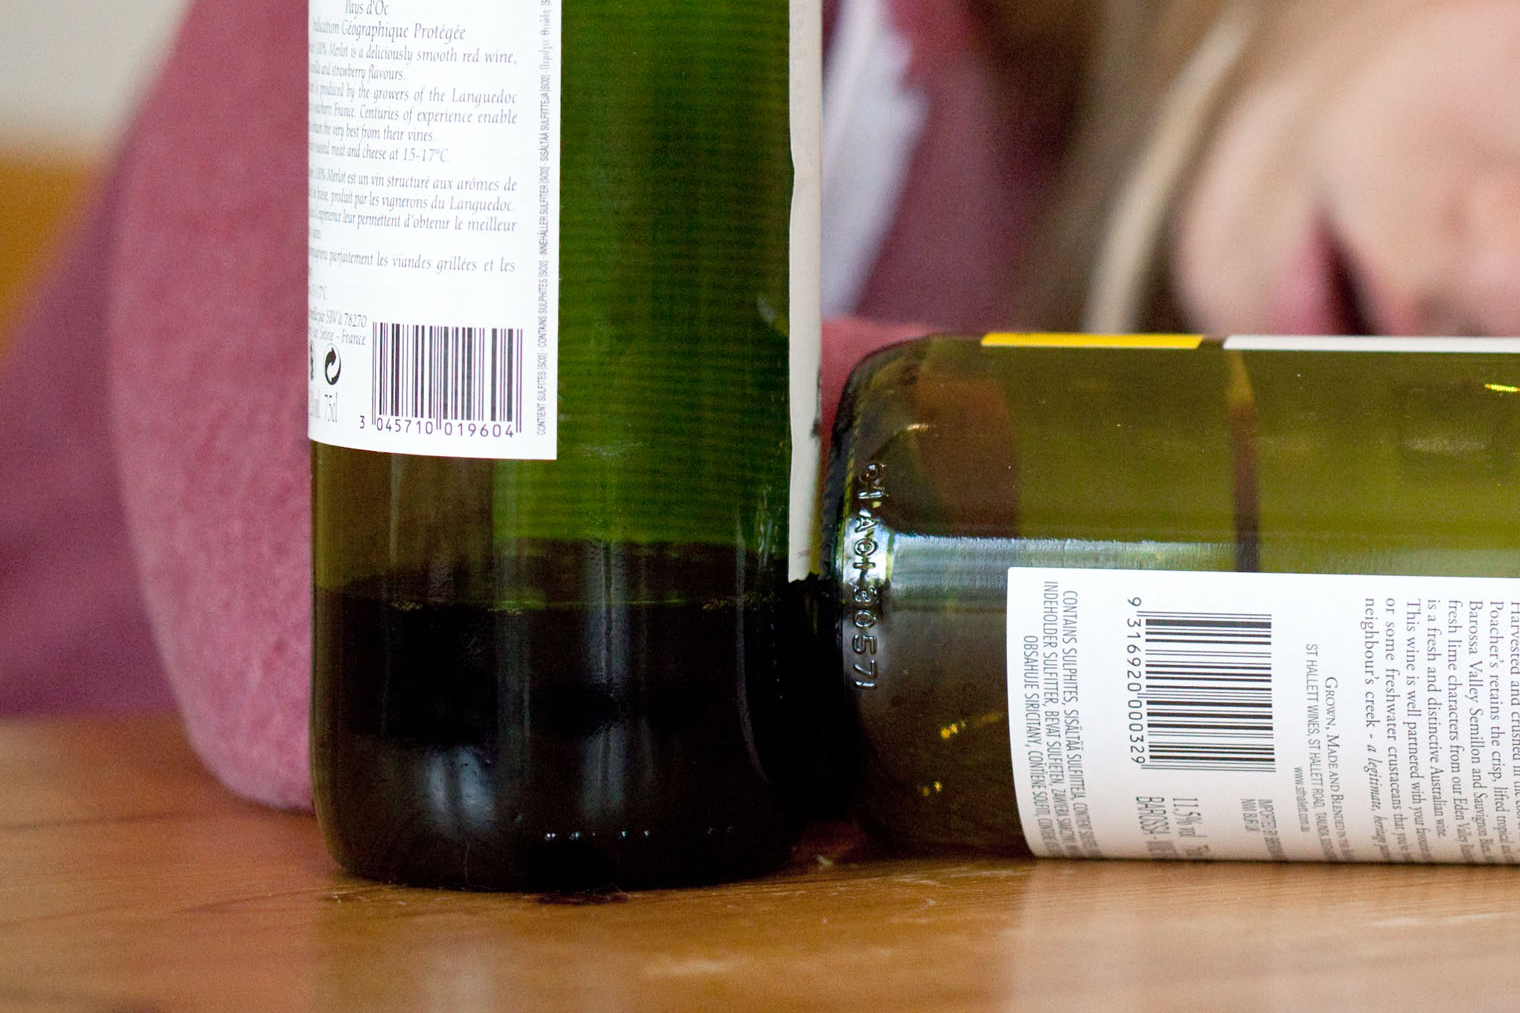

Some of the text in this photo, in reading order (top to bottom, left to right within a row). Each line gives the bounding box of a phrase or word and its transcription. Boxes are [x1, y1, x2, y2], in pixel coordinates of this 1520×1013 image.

[342, 19, 409, 42] Géographique
[414, 22, 466, 44] Protégée
[366, 44, 413, 66] deliciously
[417, 47, 458, 63] smooth
[462, 47, 480, 63] red
[368, 64, 406, 82] flavours.
[373, 90, 409, 104] growers
[414, 86, 426, 105] of
[429, 86, 446, 102] the
[452, 88, 518, 107] Languedoc
[360, 105, 518, 127] Centuries of experience enable
[361, 124, 381, 143] from
[383, 125, 404, 141] their
[362, 144, 387, 159] cheese
[389, 147, 399, 160] at
[387, 174, 430, 189] structuré
[432, 179, 454, 190] aux
[456, 176, 500, 191] arômes
[503, 175, 518, 191] de
[354, 193, 367, 209] par
[369, 190, 380, 206] les
[382, 194, 428, 211] vignerons
[431, 194, 445, 210] du
[357, 213, 401, 230] permettent
[404, 213, 451, 229] d'obtenir
[454, 215, 464, 231] le
[468, 216, 518, 232] meilleur
[377, 251, 389, 267] les
[392, 254, 432, 269] viandes
[436, 255, 478, 274] grillées
[484, 259, 494, 272] et
[500, 256, 516, 272] les
[344, 312, 368, 328] 78270
[537, 316, 548, 348] CONTAINS
[342, 329, 367, 346] France
[359, 415, 514, 438] 3 045710 019604
[1043, 581, 1060, 648] INDEHOLDER
[1062, 590, 1079, 645] CONTAINS
[1427, 598, 1441, 611] is
[1427, 614, 1437, 623] a
[1447, 599, 1463, 634] fresh
[1361, 597, 1380, 685] neighbour's
[1427, 626, 1443, 661] fresh
[1469, 600, 1484, 655] Barossa
[1489, 600, 1506, 669] Poacher's
[1306, 643, 1319, 657] ST
[1448, 638, 1464, 670] lime
[1023, 635, 1042, 748] OBSAHUJE SIRICITANY,
[1042, 651, 1060, 707] SULFITTER,
[1061, 647, 1079, 706] SULPHITES,
[1127, 596, 1147, 764] 9 316920 000329
[1306, 659, 1319, 702] HALLETT
[1427, 666, 1442, 693] and
[1465, 660, 1485, 703] Valley
[1365, 690, 1381, 728] creek
[1385, 597, 1408, 830] or some freshwater crustaceans that
[1403, 598, 1428, 826] This wine is well partnered with your
[1448, 674, 1465, 741] characters
[1489, 674, 1505, 721] retains
[1044, 710, 1062, 738] BEVAT
[1063, 709, 1084, 751] SISÄLTÄÄ
[1306, 704, 1320, 736] WINES,
[1428, 697, 1445, 763] distinctive
[1469, 707, 1486, 764] Semillon
[1491, 726, 1507, 746] the
[1309, 738, 1321, 752] ST
[1324, 676, 1344, 830] GROWN, MADE AND BLENDED
[1367, 744, 1377, 753] a
[1450, 744, 1467, 773] from
[1046, 741, 1066, 786] SULFIETEN,
[1310, 752, 1324, 786] HALLETT
[1471, 767, 1488, 789] and
[1486, 750, 1505, 783] crisp,
[1364, 757, 1384, 812] legitimate,
[1430, 765, 1448, 817] Australian
[1451, 776, 1462, 796] our
[1493, 786, 1510, 813] lifted
[1136, 796, 1171, 835] BAROSSA
[1453, 797, 1469, 820] Eden
